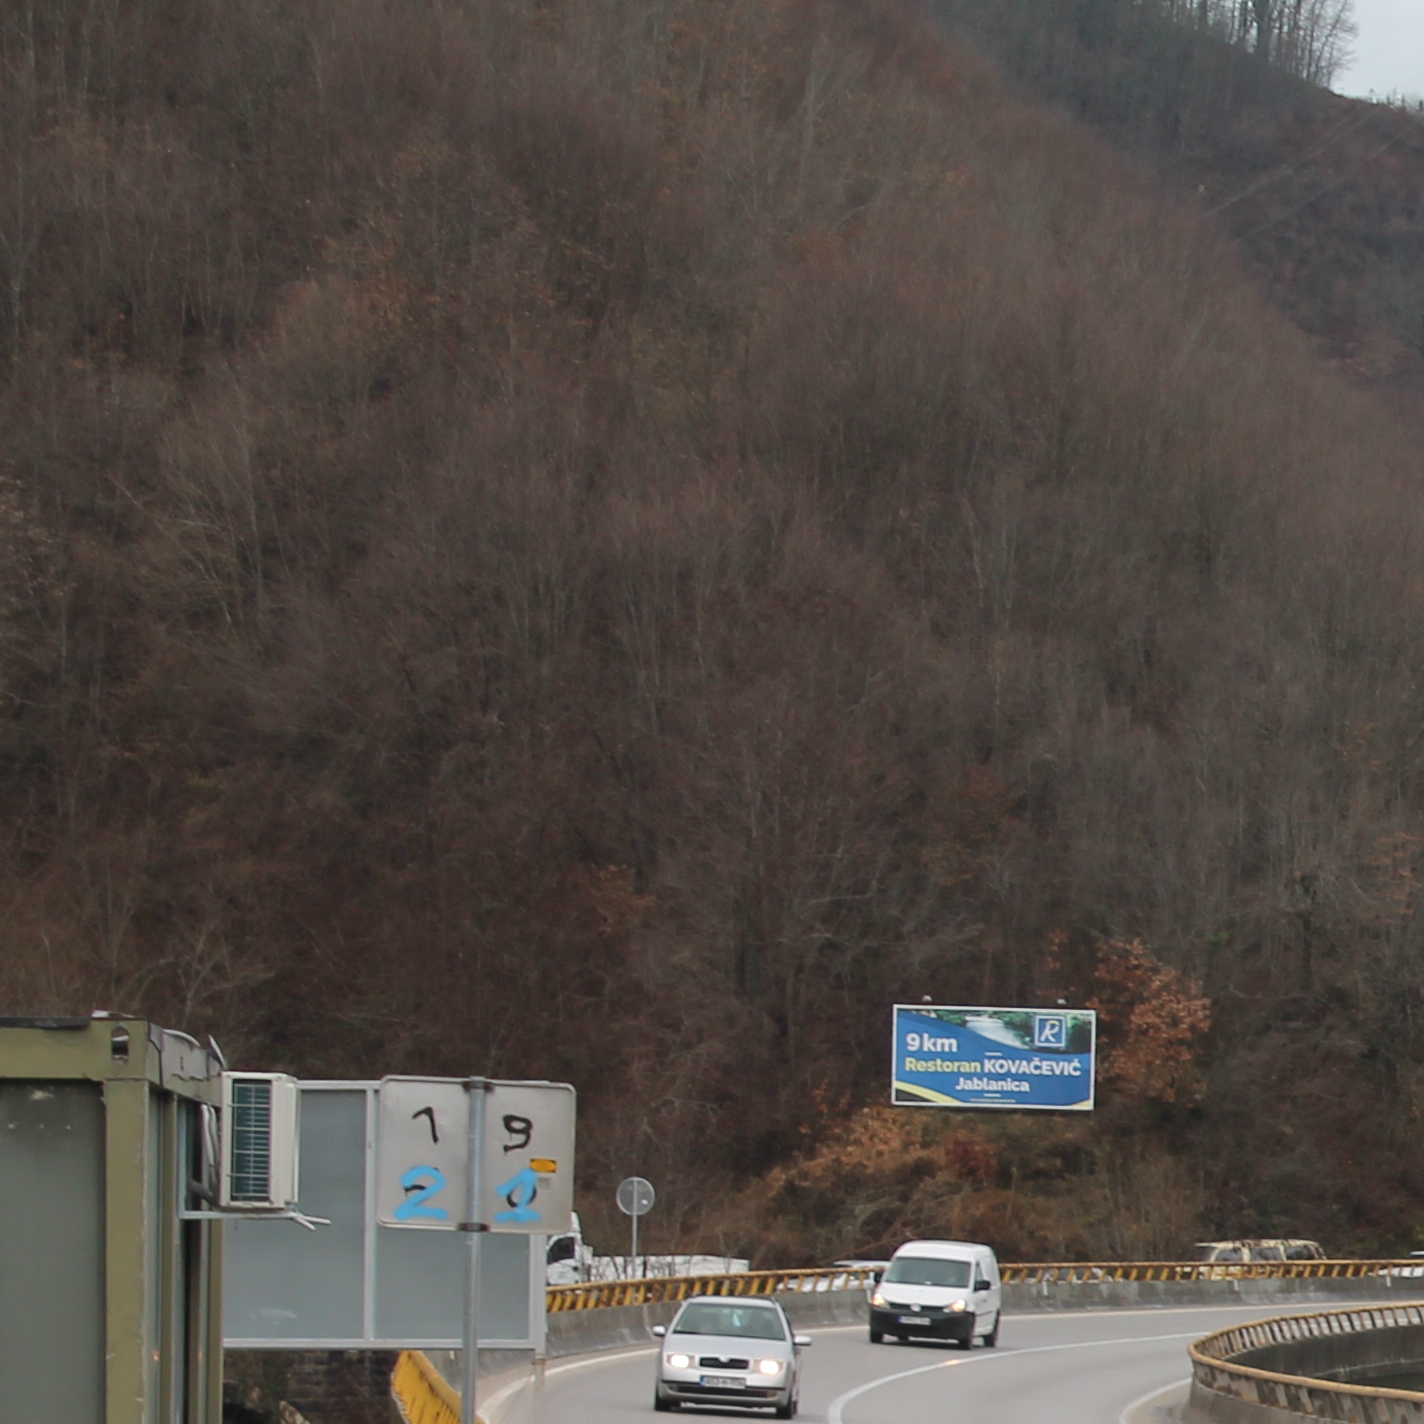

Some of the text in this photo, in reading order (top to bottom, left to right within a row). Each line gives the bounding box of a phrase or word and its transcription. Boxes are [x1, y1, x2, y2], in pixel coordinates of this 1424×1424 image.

[906, 1033, 957, 1052] 9 km
[905, 1056, 1081, 1076] Restoran KOVAČEVIĆ
[955, 1077, 1030, 1092] Jablanica
[502, 1114, 532, 1155] 9
[394, 1165, 448, 1221] 2
